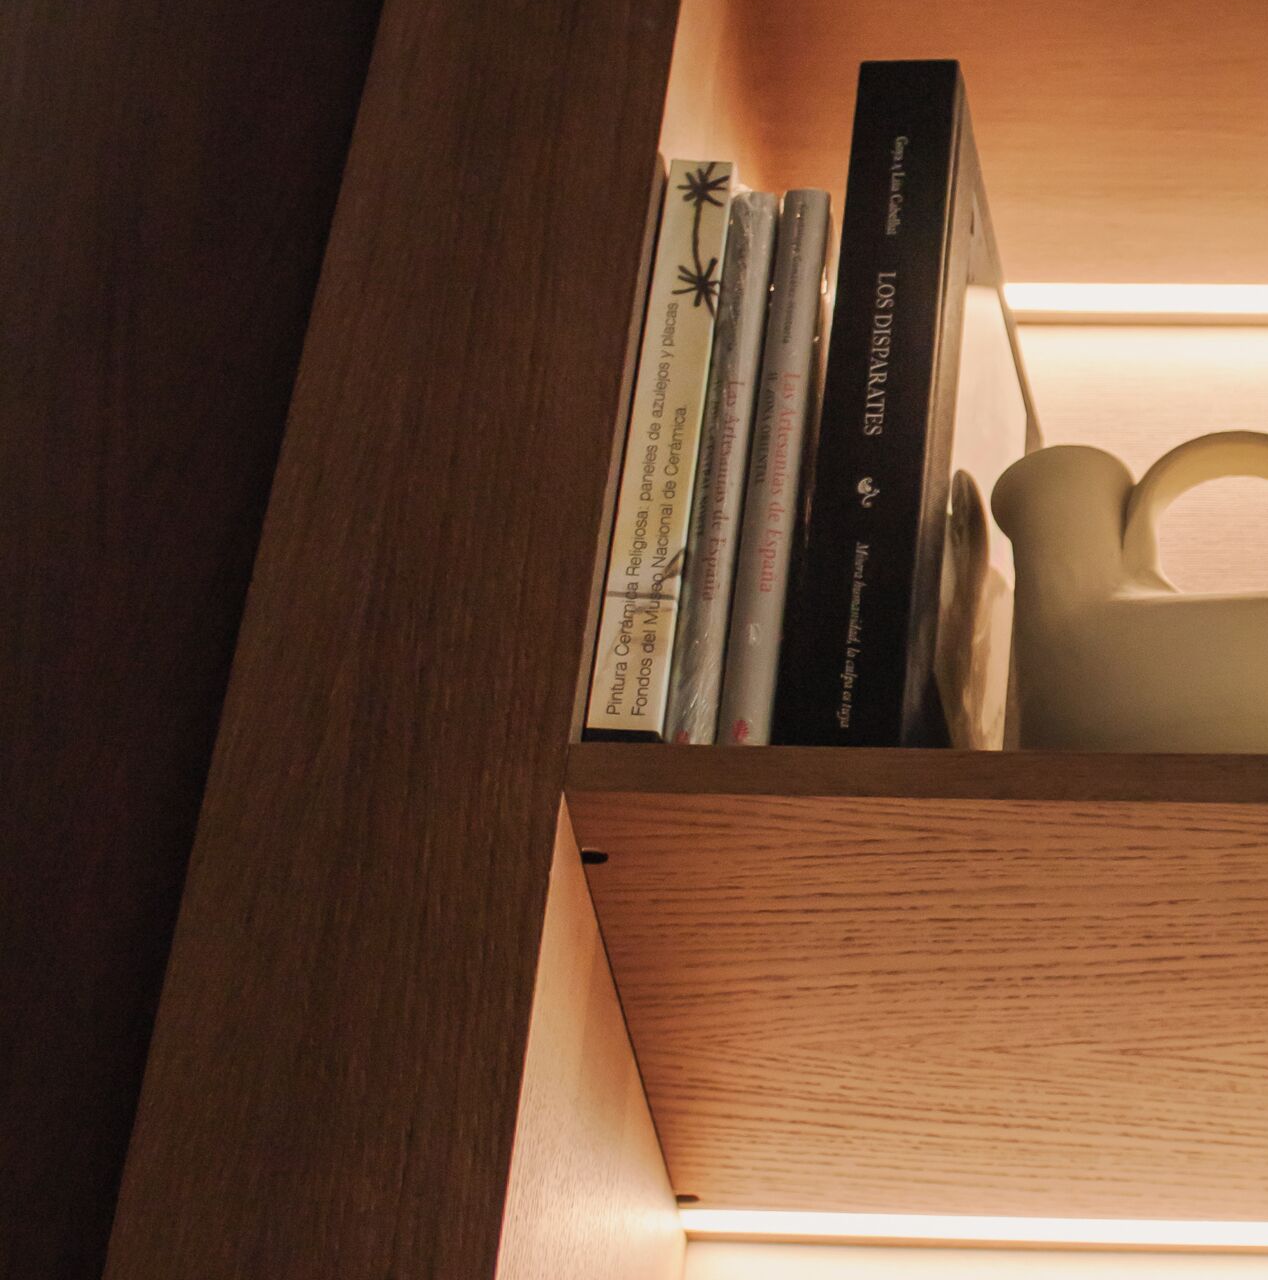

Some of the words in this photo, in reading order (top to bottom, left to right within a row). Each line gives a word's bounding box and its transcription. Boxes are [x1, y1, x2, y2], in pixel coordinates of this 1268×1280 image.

[875, 270, 897, 309] LOS
[658, 303, 681, 346] placas
[659, 349, 674, 358] y
[862, 312, 893, 434] DISPARATES
[648, 361, 673, 419] azulejos
[724, 380, 745, 406] Las
[779, 372, 802, 398] Las
[644, 421, 661, 440] de
[714, 414, 740, 500] Artesanías
[769, 407, 798, 493] Artesanías
[636, 444, 661, 502] paneles
[659, 480, 676, 499] de
[650, 503, 673, 568] Nacional
[711, 505, 730, 529] de
[766, 498, 788, 520] de
[625, 507, 652, 577] Religiosa:
[697, 533, 727, 599] España
[753, 526, 783, 592] España
[612, 581, 640, 656] Cerámica
[642, 572, 664, 624] Museo
[638, 629, 656, 653] del
[604, 661, 629, 715] Pintura
[630, 656, 653, 716] Fondos
